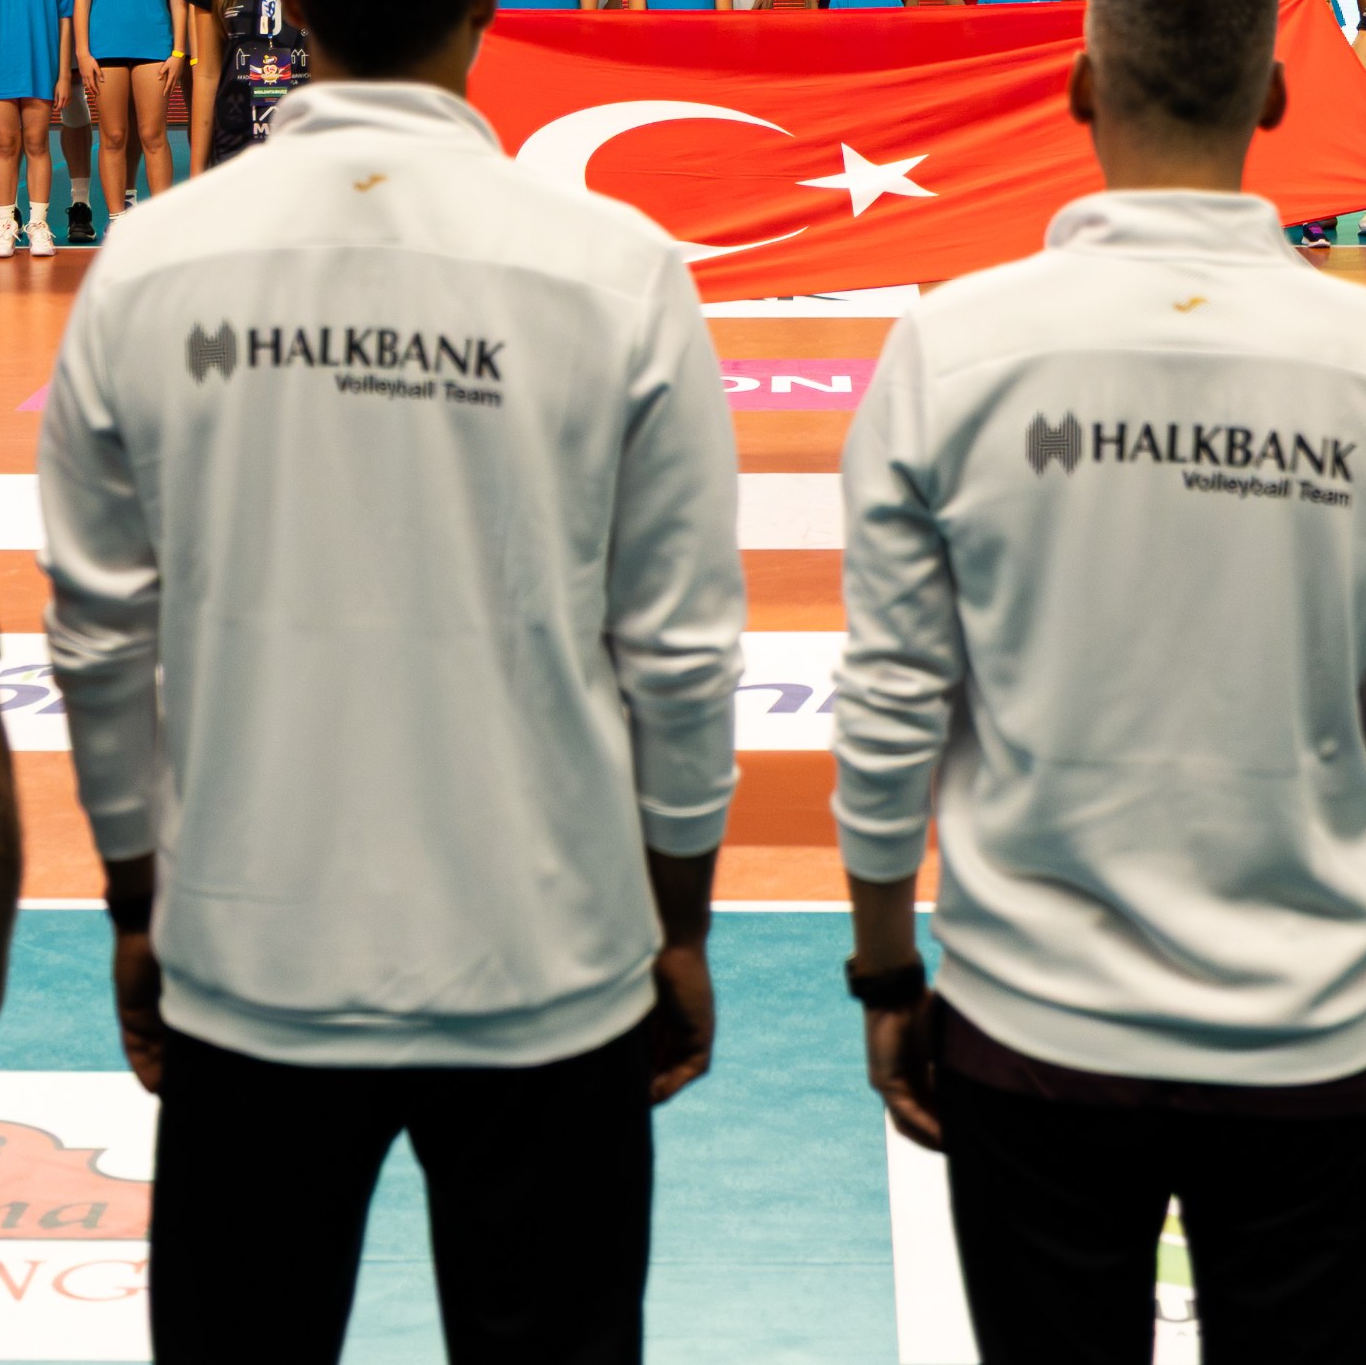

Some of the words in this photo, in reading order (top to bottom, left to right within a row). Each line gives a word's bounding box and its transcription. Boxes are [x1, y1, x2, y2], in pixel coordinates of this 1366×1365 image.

[247, 327, 505, 383] HALKBANK
[336, 373, 435, 402] Volleyball
[444, 380, 502, 407] Team
[1092, 421, 1357, 482] HALKBANK
[1182, 470, 1290, 502] Volleyball
[1298, 477, 1352, 507] Team
